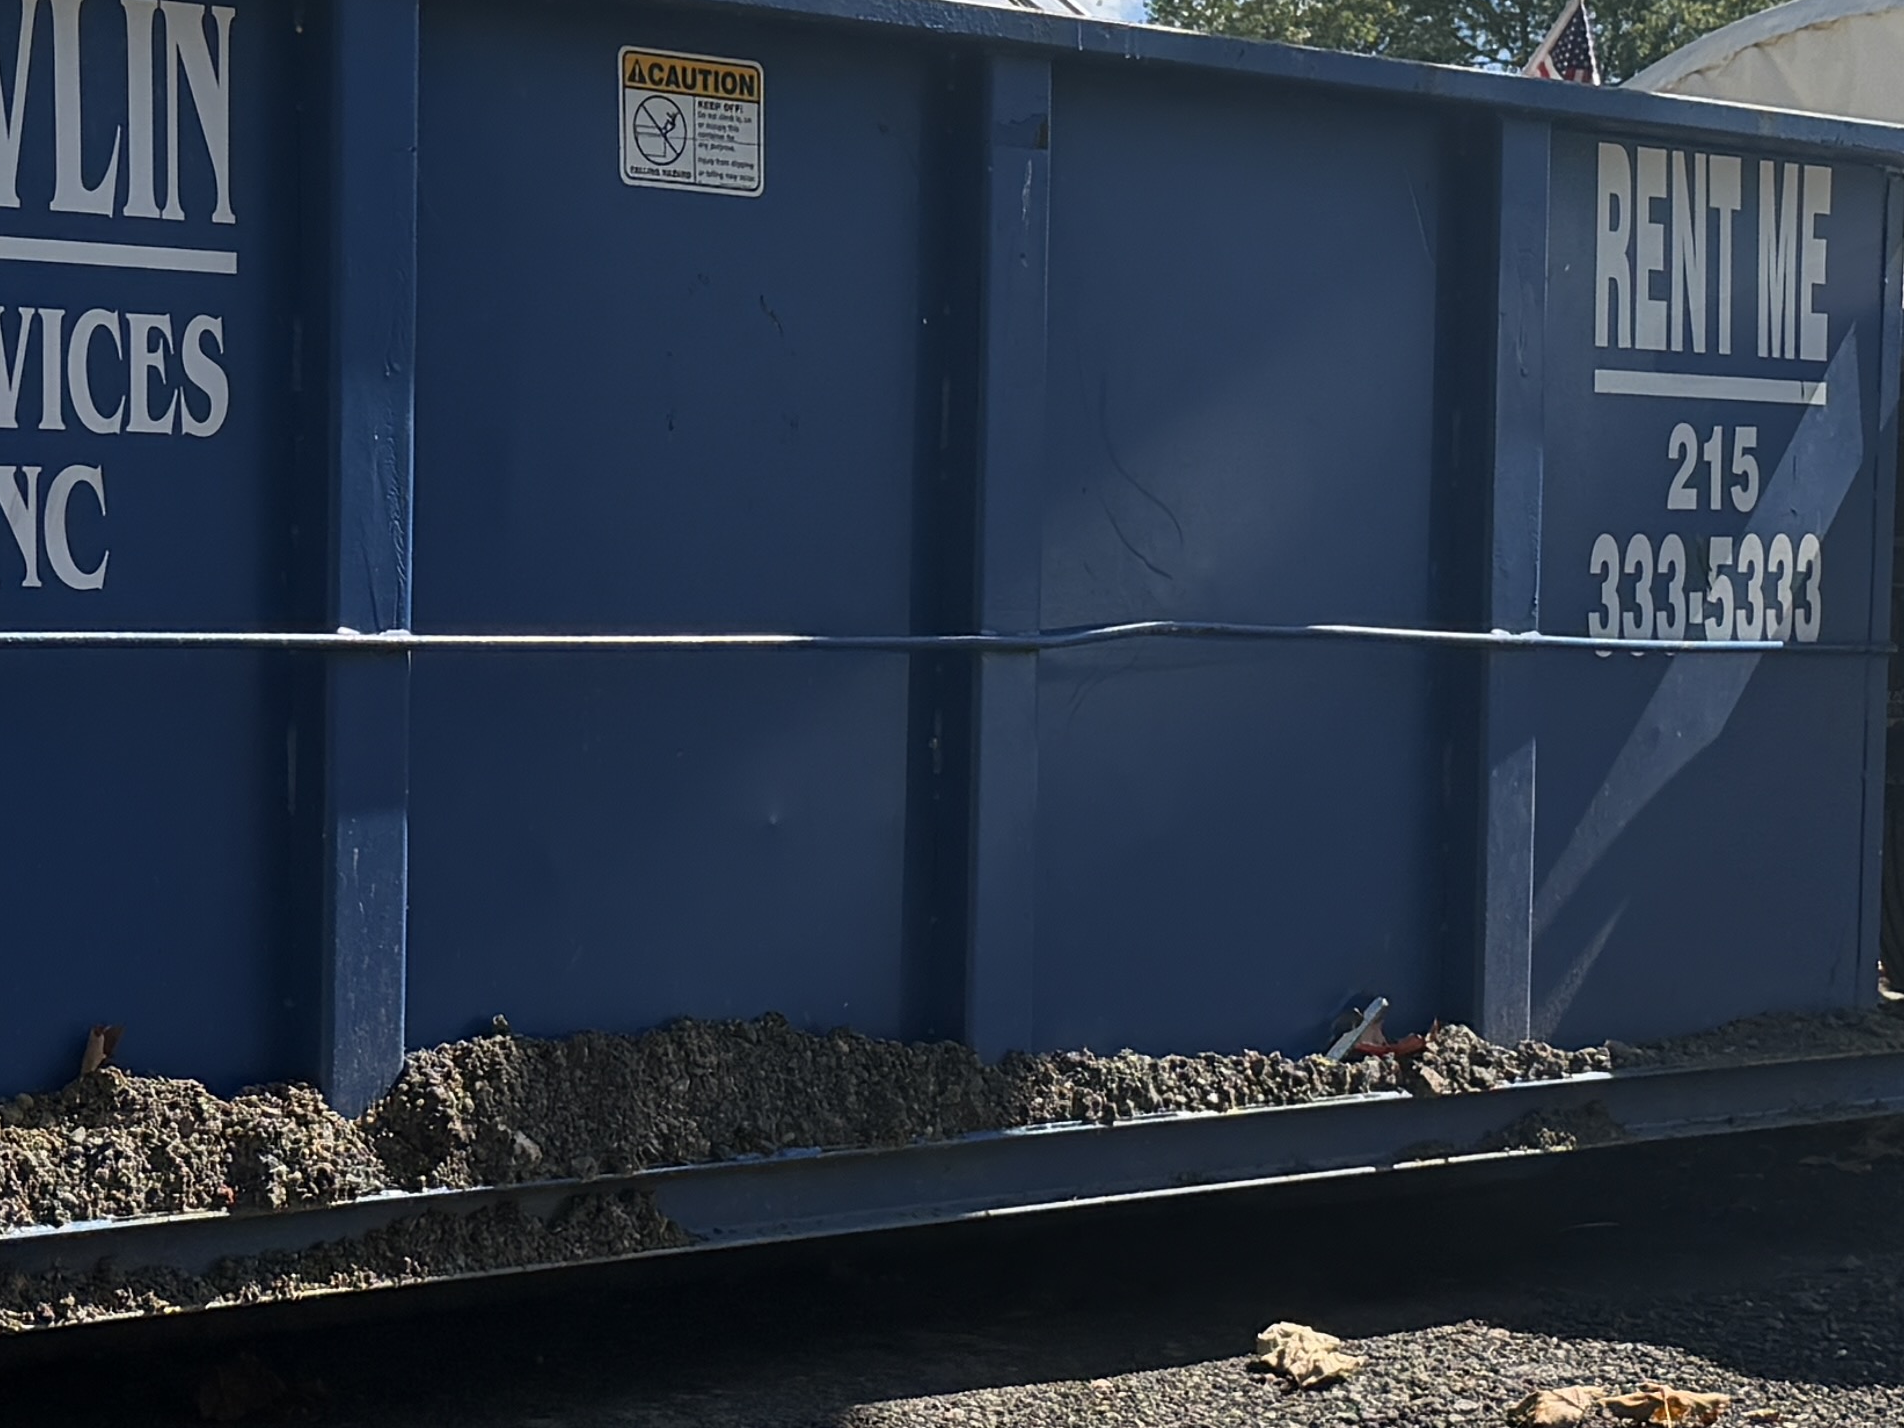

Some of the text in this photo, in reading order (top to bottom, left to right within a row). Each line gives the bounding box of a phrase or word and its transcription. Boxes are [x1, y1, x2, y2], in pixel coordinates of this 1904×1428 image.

[647, 62, 755, 97] CAUTION
[1595, 142, 1832, 361] RENT ME
[1667, 422, 1759, 513] 215
[1588, 532, 1823, 657] 333-5333
